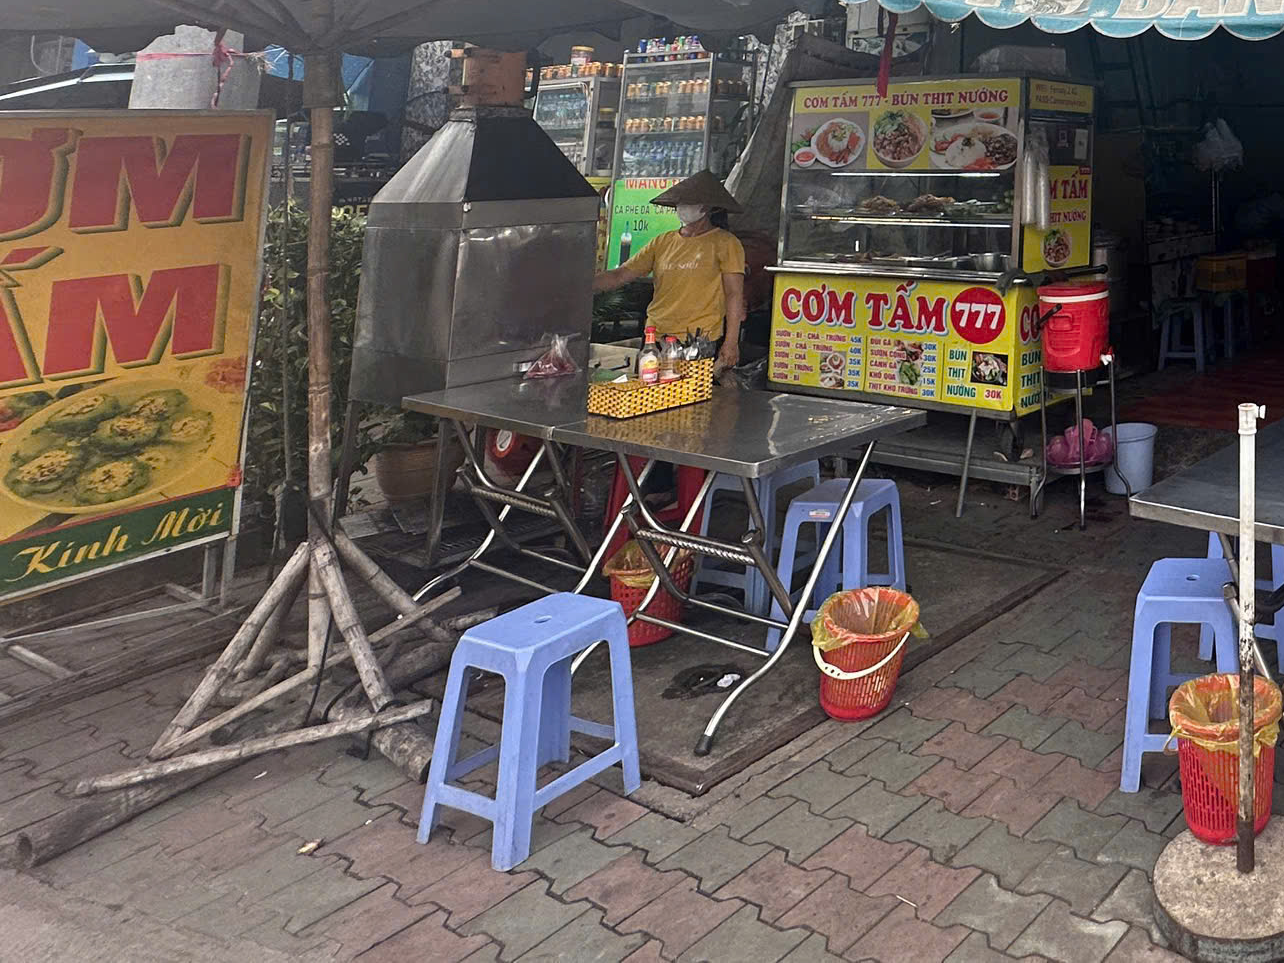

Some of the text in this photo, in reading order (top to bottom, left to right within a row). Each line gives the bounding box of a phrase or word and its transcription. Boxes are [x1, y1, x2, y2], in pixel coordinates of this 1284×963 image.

[832, 90, 857, 108] TẤM
[862, 94, 881, 108] 777
[892, 91, 919, 106] BÚN
[923, 92, 954, 108] THỊT
[958, 87, 1008, 104] NƯỚNG
[781, 280, 1002, 335] CƠM TẤM 777
[949, 349, 967, 361] BÚN
[948, 367, 966, 380] THỊT
[946, 384, 976, 398] NƯỚNG
[985, 389, 1002, 399] 30K
